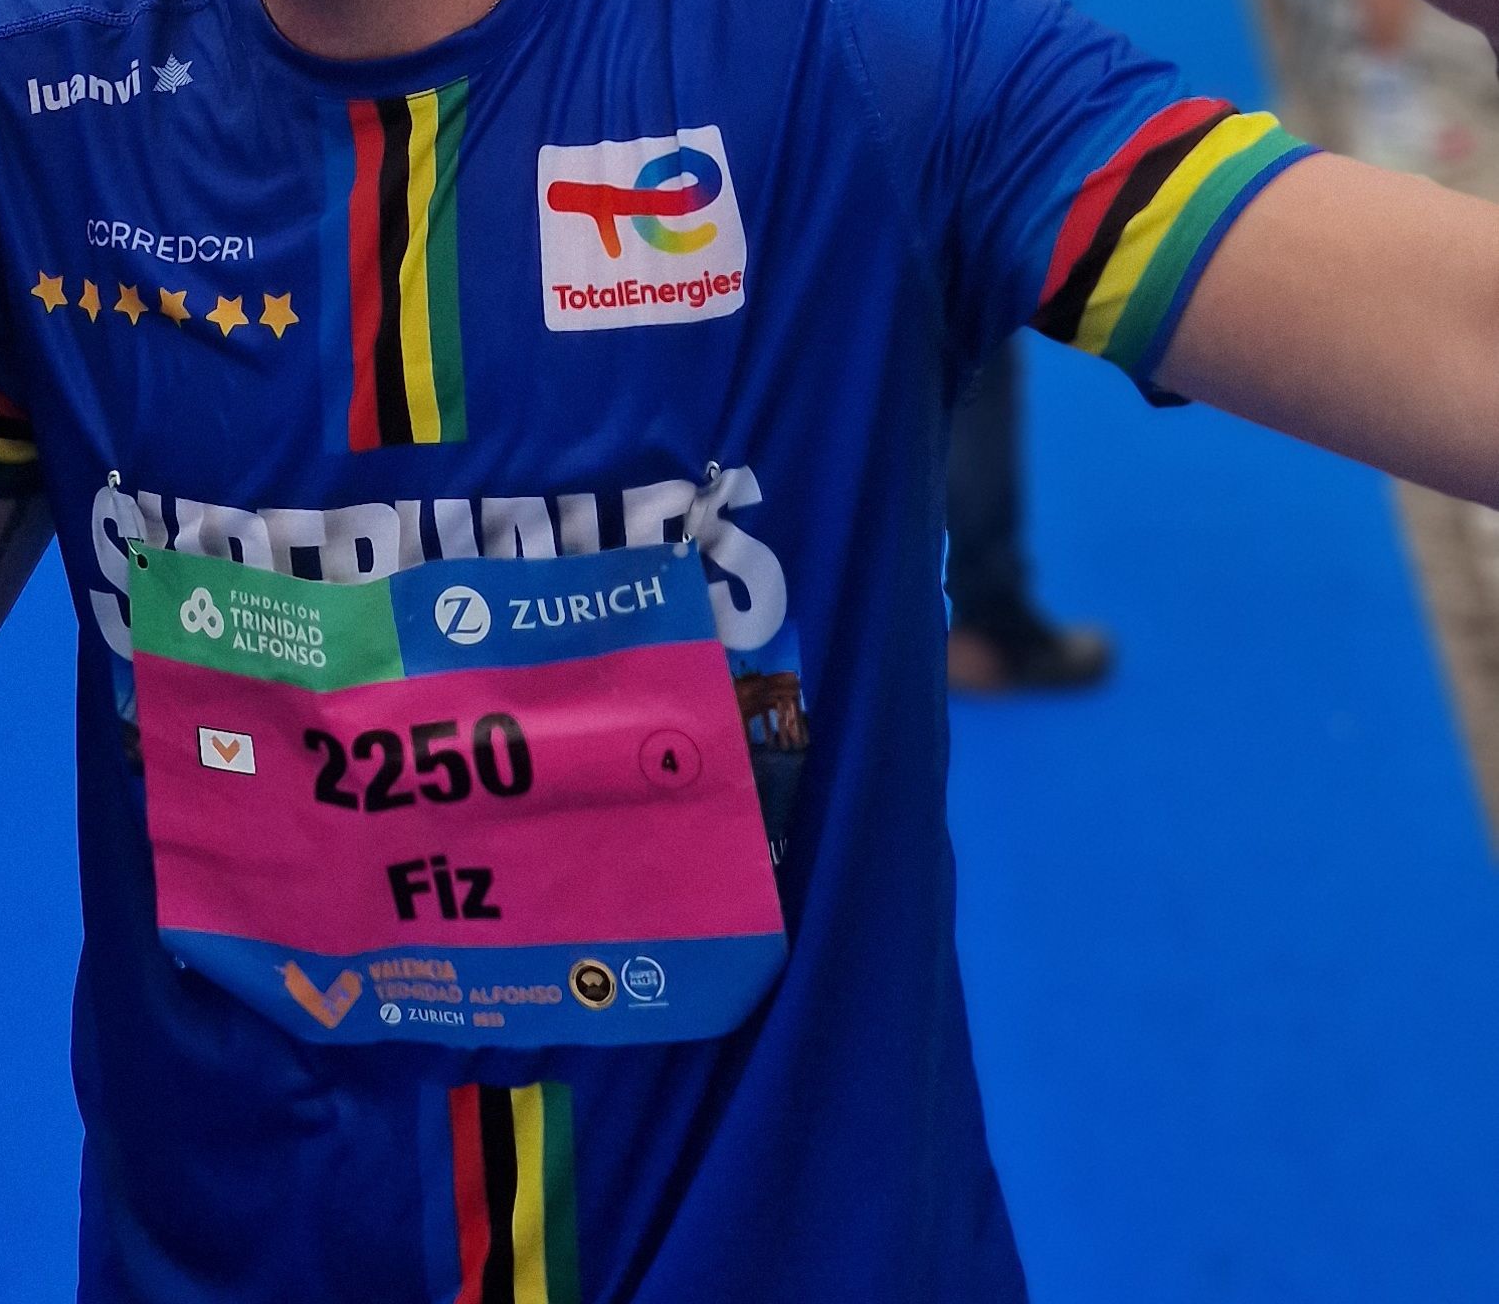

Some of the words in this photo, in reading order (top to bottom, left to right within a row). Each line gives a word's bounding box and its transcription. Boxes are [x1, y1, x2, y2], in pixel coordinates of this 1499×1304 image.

[28, 58, 141, 114] luanvi
[552, 270, 742, 310] TotalEnergies
[229, 607, 323, 646] TRINIDAD
[508, 576, 666, 630] ZURICH
[232, 631, 327, 668] ALFONSO
[304, 712, 533, 813] 2250
[387, 854, 501, 921] Fiz
[408, 1008, 465, 1026] ZURICH
